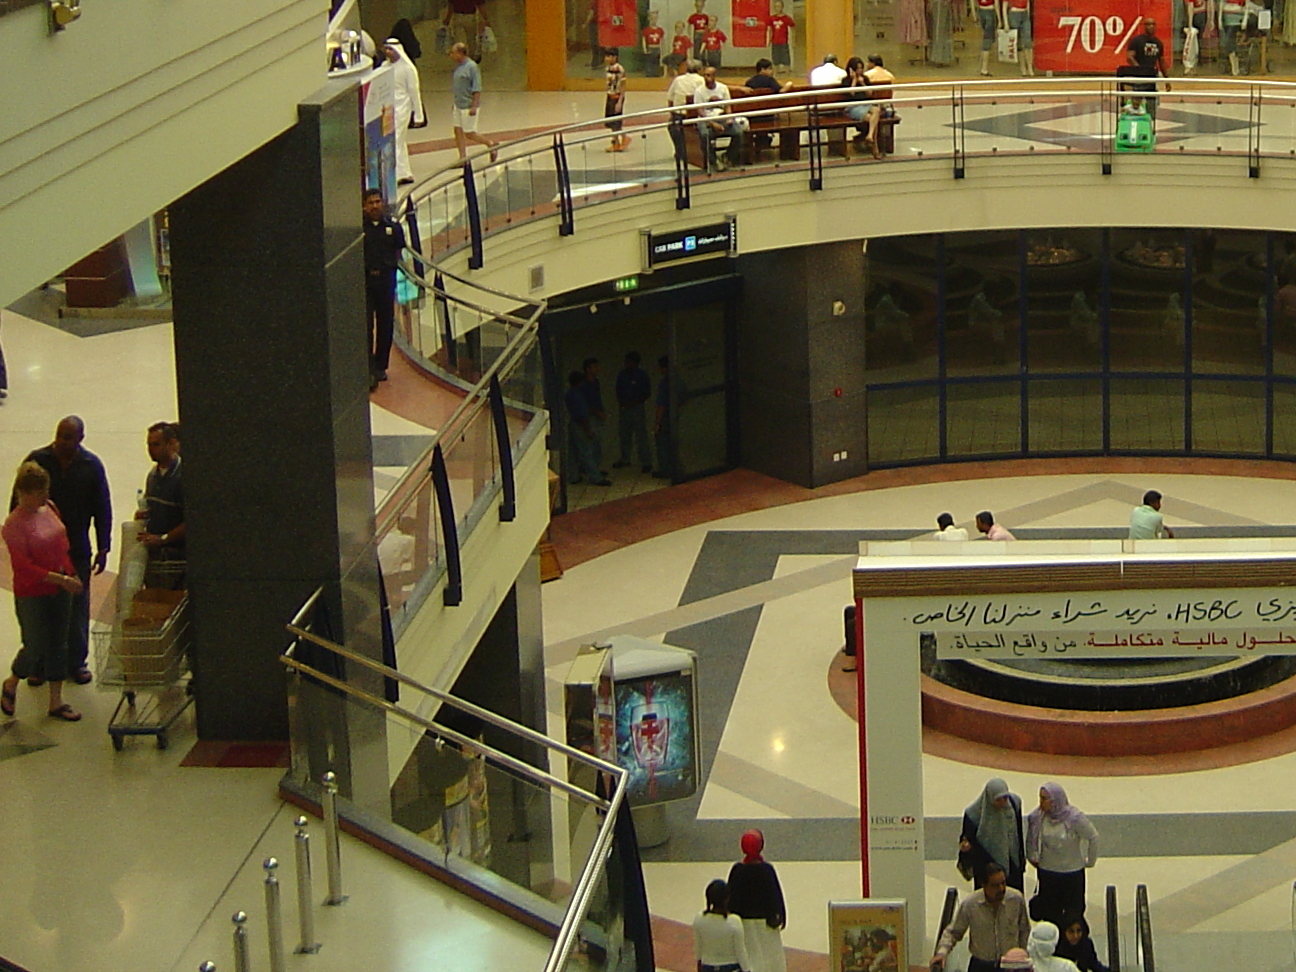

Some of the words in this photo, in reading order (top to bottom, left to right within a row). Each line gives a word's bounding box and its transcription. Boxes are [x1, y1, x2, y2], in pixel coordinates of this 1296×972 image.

[1058, 15, 1143, 54] 70%
[1051, 599, 1108, 624] شراء
[1115, 604, 1158, 625] نريد
[1012, 634, 1048, 656] واقع
[1055, 636, 1077, 652] من
[1172, 632, 1228, 650] مالية
[1236, 631, 1296, 650] حلول
